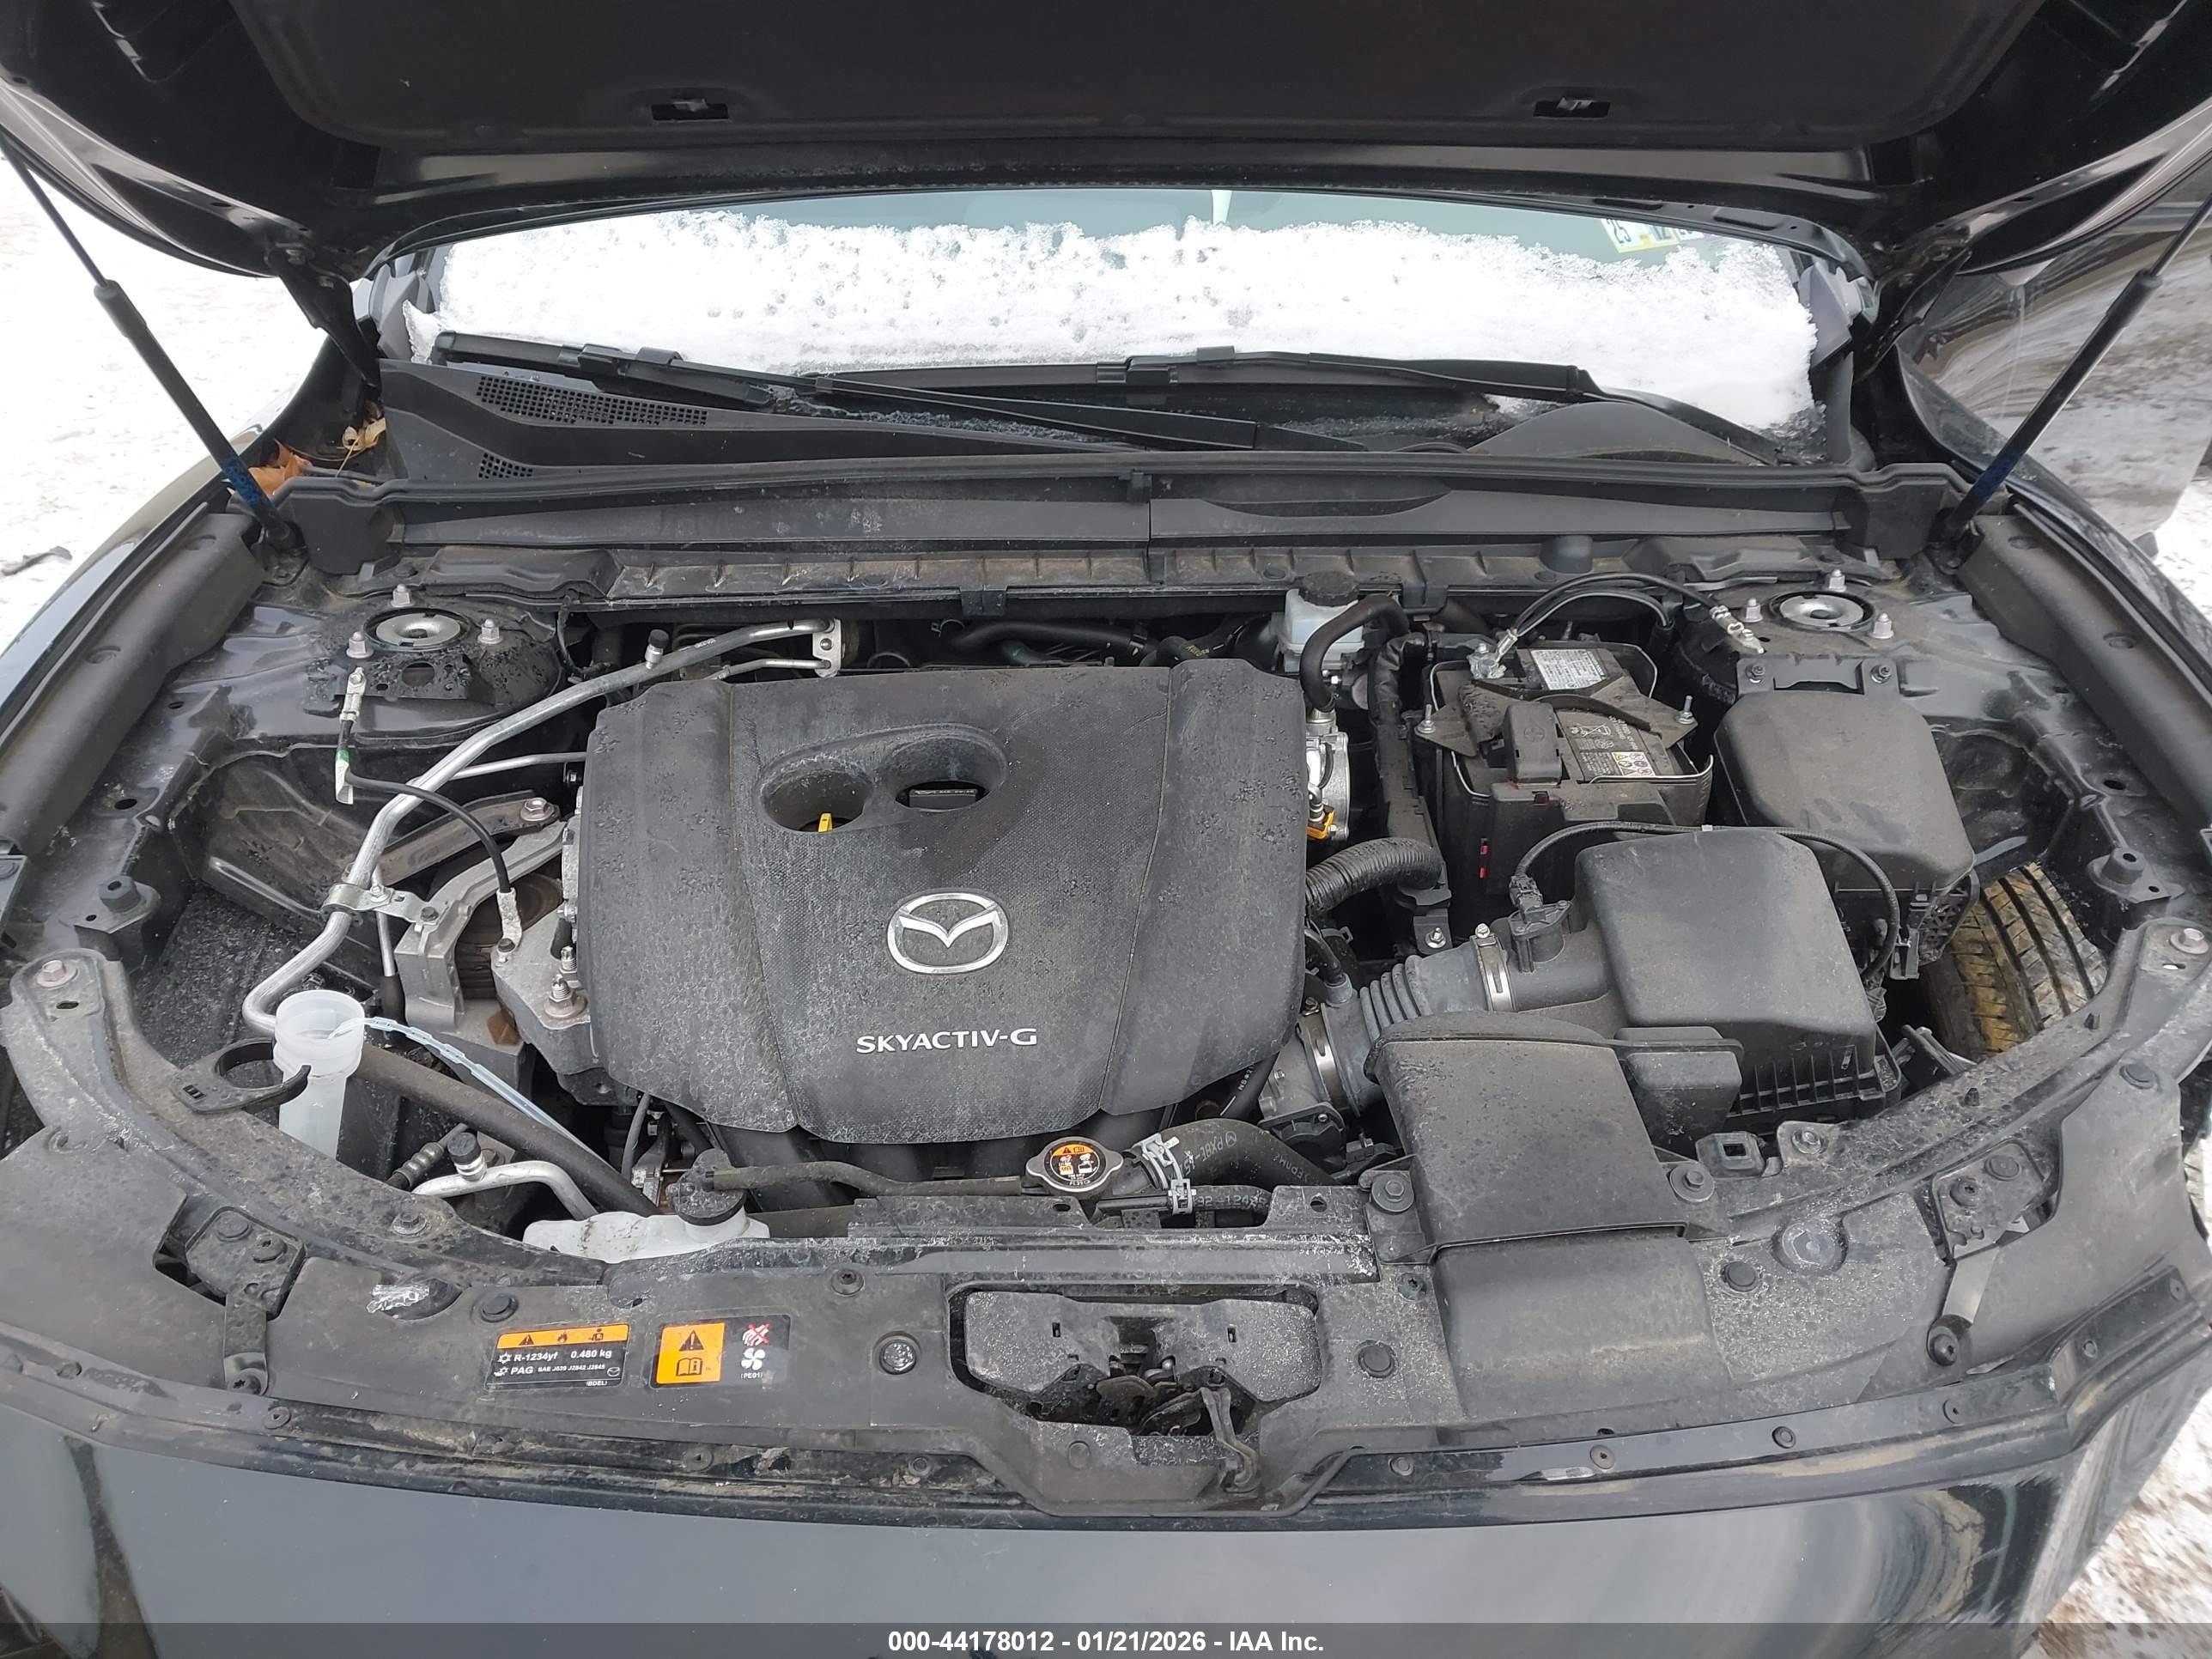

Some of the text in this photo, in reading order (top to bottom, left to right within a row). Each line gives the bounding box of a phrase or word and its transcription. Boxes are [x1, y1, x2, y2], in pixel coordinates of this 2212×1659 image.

[856, 1027, 1038, 1054] SKYACTIV-G
[514, 1349, 612, 1362] R-1234yf 0.480 kg
[510, 1366, 534, 1375] PAG
